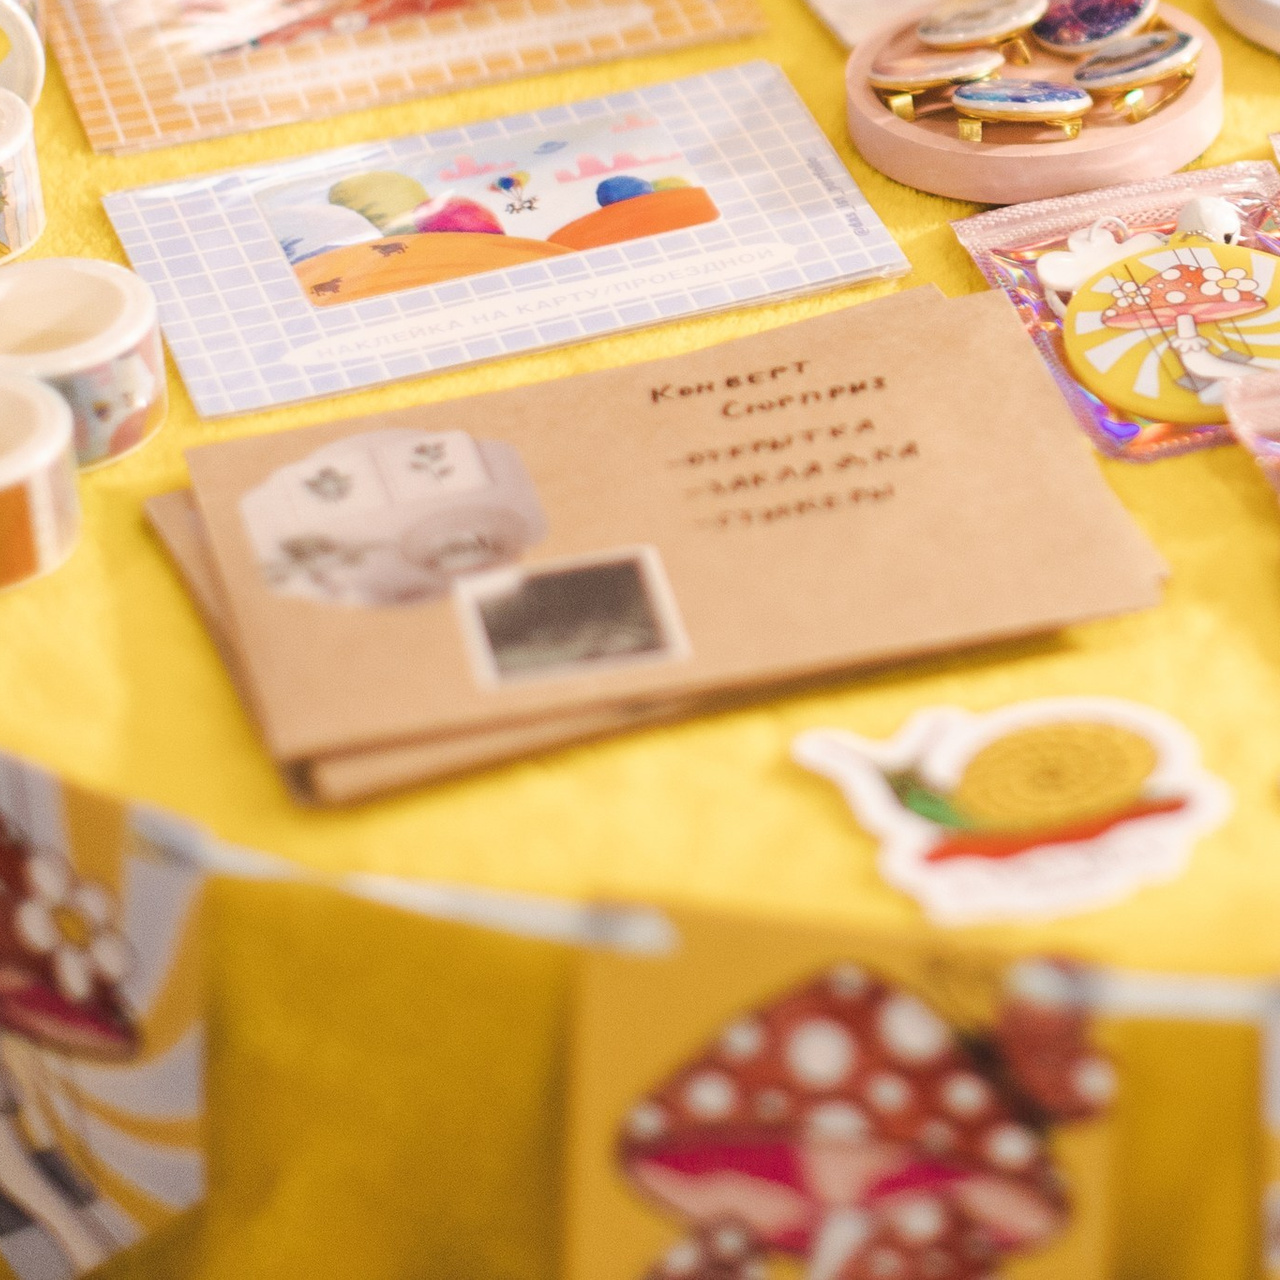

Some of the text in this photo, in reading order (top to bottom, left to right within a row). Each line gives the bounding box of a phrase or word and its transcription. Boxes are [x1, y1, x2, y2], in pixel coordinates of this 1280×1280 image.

[316, 248, 776, 359] НАКЛЕЙКА НА КАРТУ/ПРОЕЗДНОЙ
